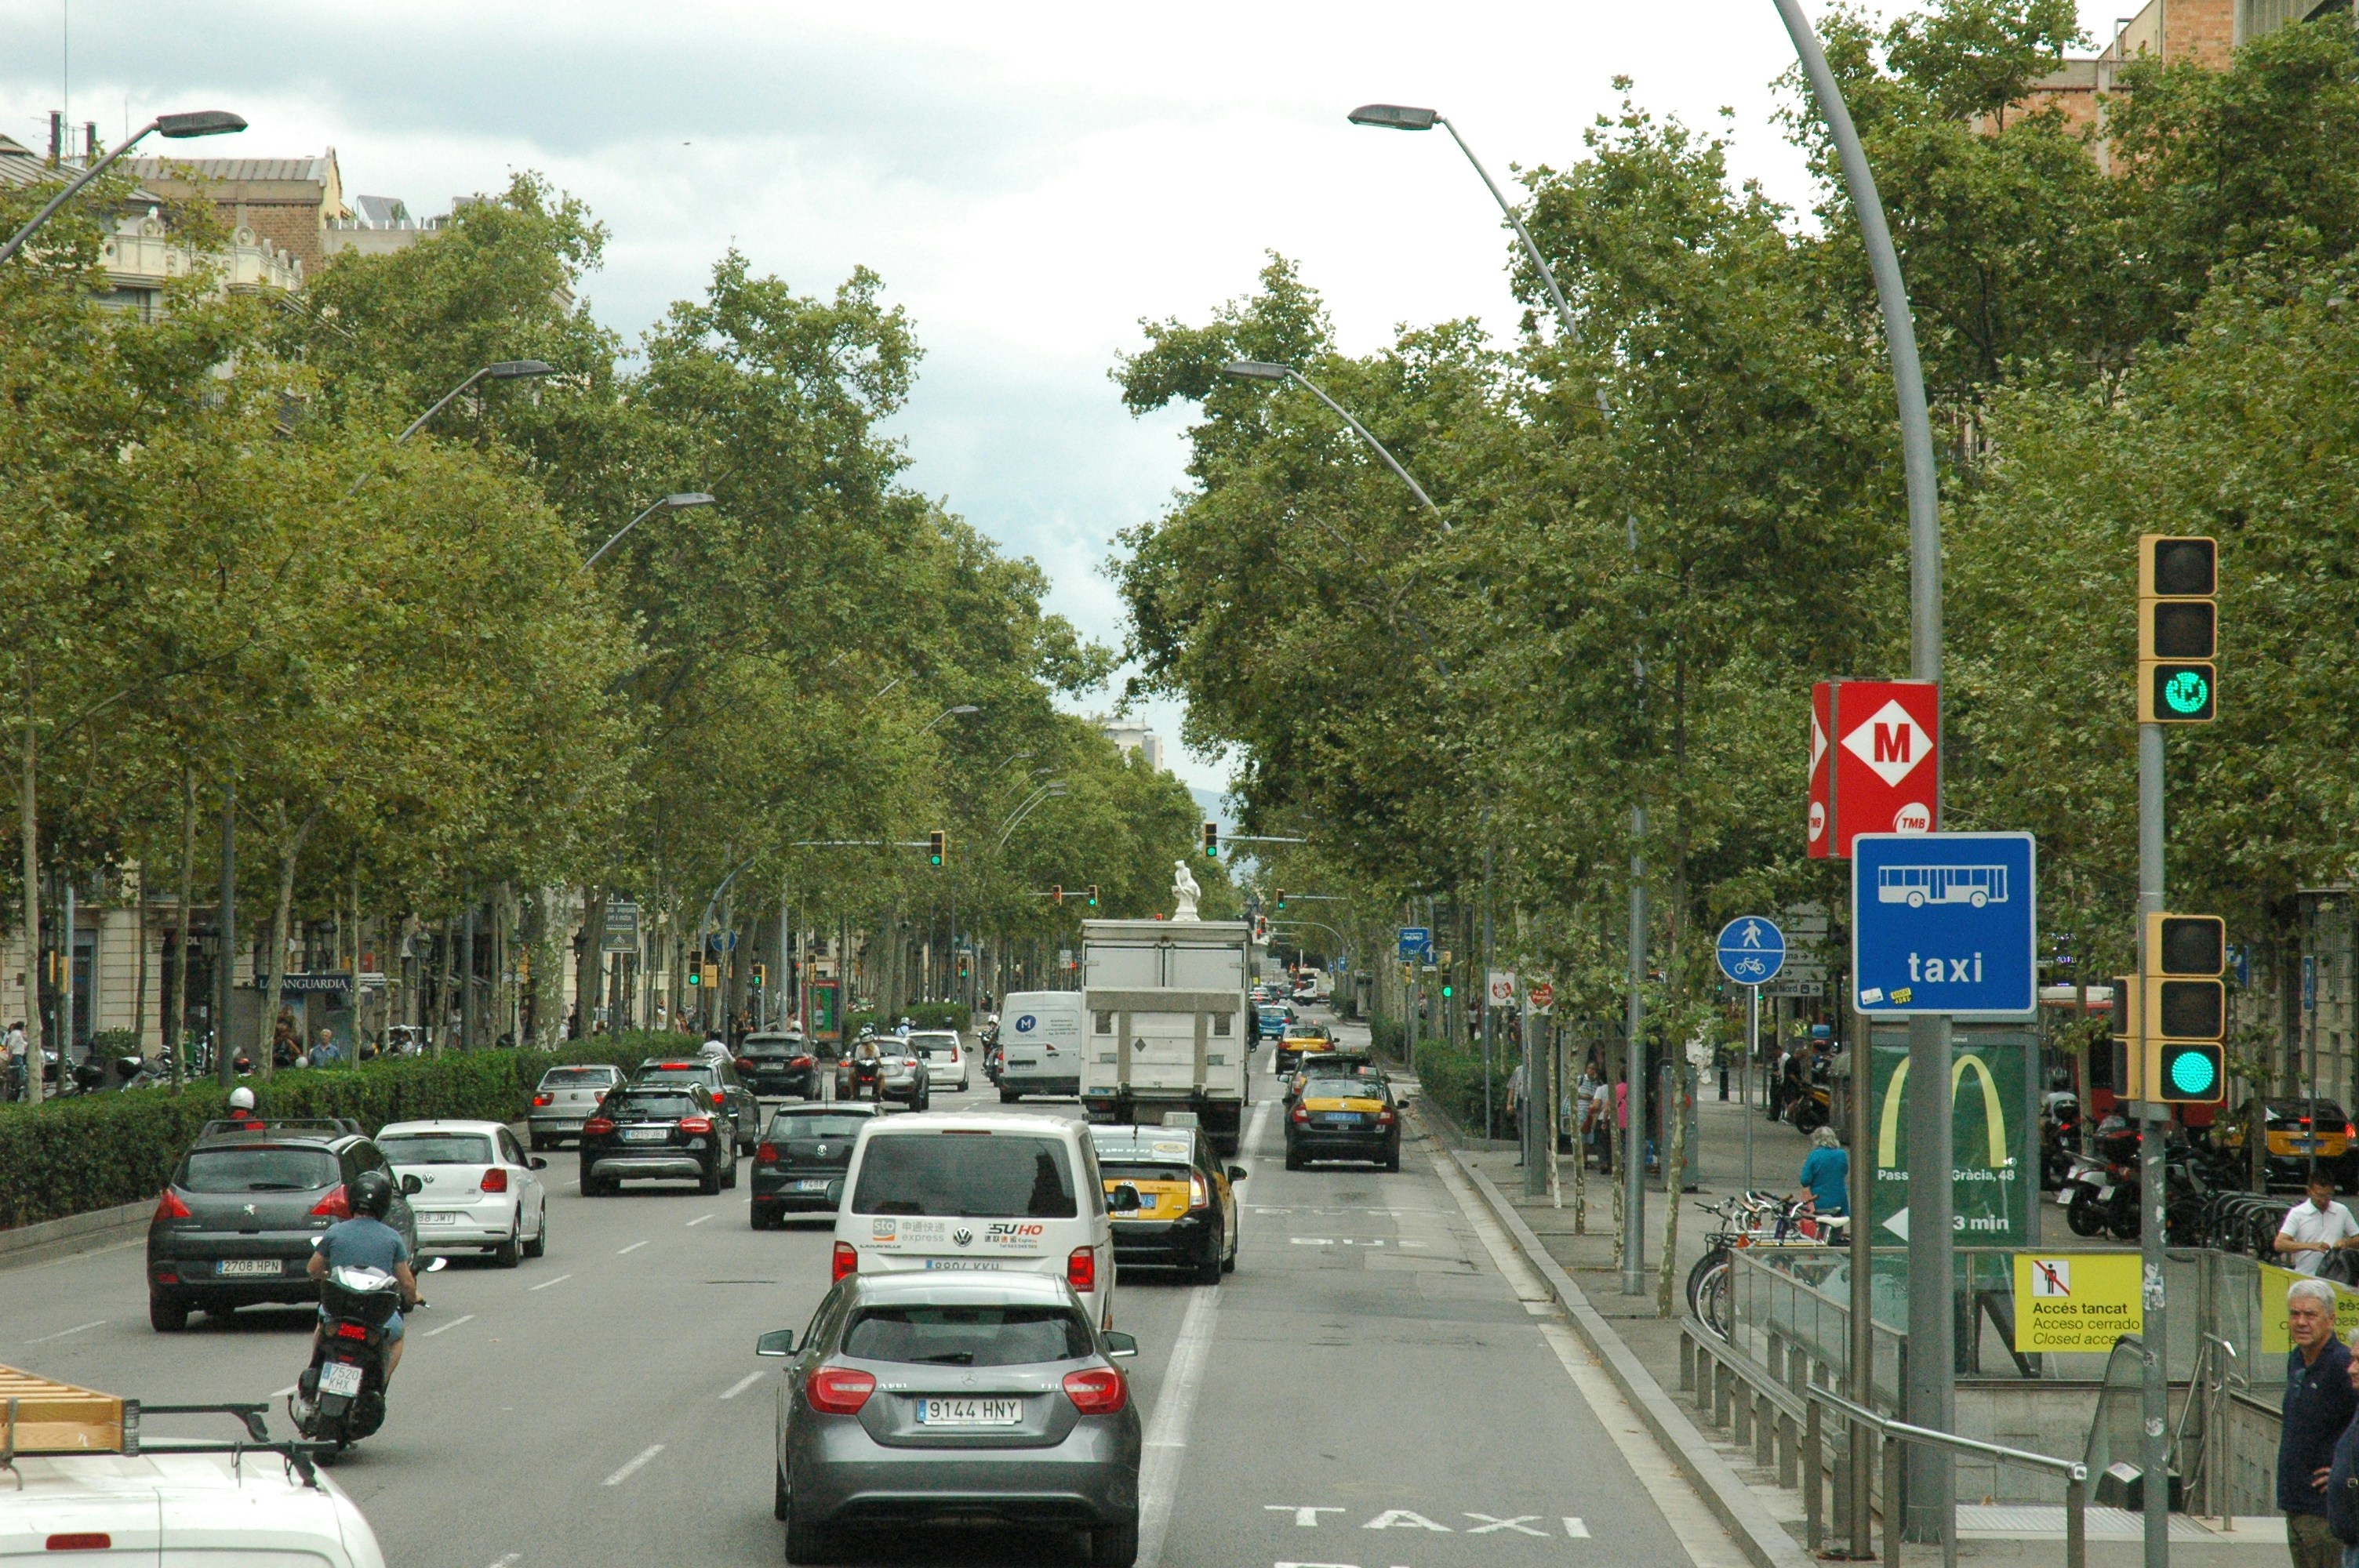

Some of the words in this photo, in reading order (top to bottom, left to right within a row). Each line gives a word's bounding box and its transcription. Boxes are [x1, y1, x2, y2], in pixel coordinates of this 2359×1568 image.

[1874, 722, 1910, 763] M
[1902, 817, 1925, 829] TMB
[1908, 952, 1982, 982] taxi
[281, 979, 347, 989] ANGUARDIA
[1780, 984, 1797, 993] Nord
[1021, 1019, 1031, 1029] M
[1877, 1170, 1909, 1181] Pass
[1952, 1169, 1997, 1182] Gràcia,
[1998, 1170, 2015, 1181] 48
[417, 1213, 431, 1222] 88
[434, 1213, 452, 1222] JMY
[1953, 1216, 1965, 1230] 3
[1970, 1214, 2009, 1230] min
[874, 1220, 896, 1232] sto
[902, 1233, 945, 1243] express
[223, 1260, 254, 1272] 2708
[256, 1259, 279, 1272] HPN
[2033, 1301, 2077, 1315] Accés
[2082, 1303, 2128, 1315] tancat
[2033, 1317, 2084, 1330] Acceso
[2088, 1318, 2140, 1330] cerrado
[2034, 1332, 2081, 1345] Closed
[2084, 1336, 2117, 1345] acce
[332, 1367, 359, 1381] 7520
[329, 1377, 350, 1390] KHX
[930, 1401, 976, 1418] 9144
[983, 1401, 1016, 1417] HNY
[1264, 1505, 1591, 1538] TAXI
